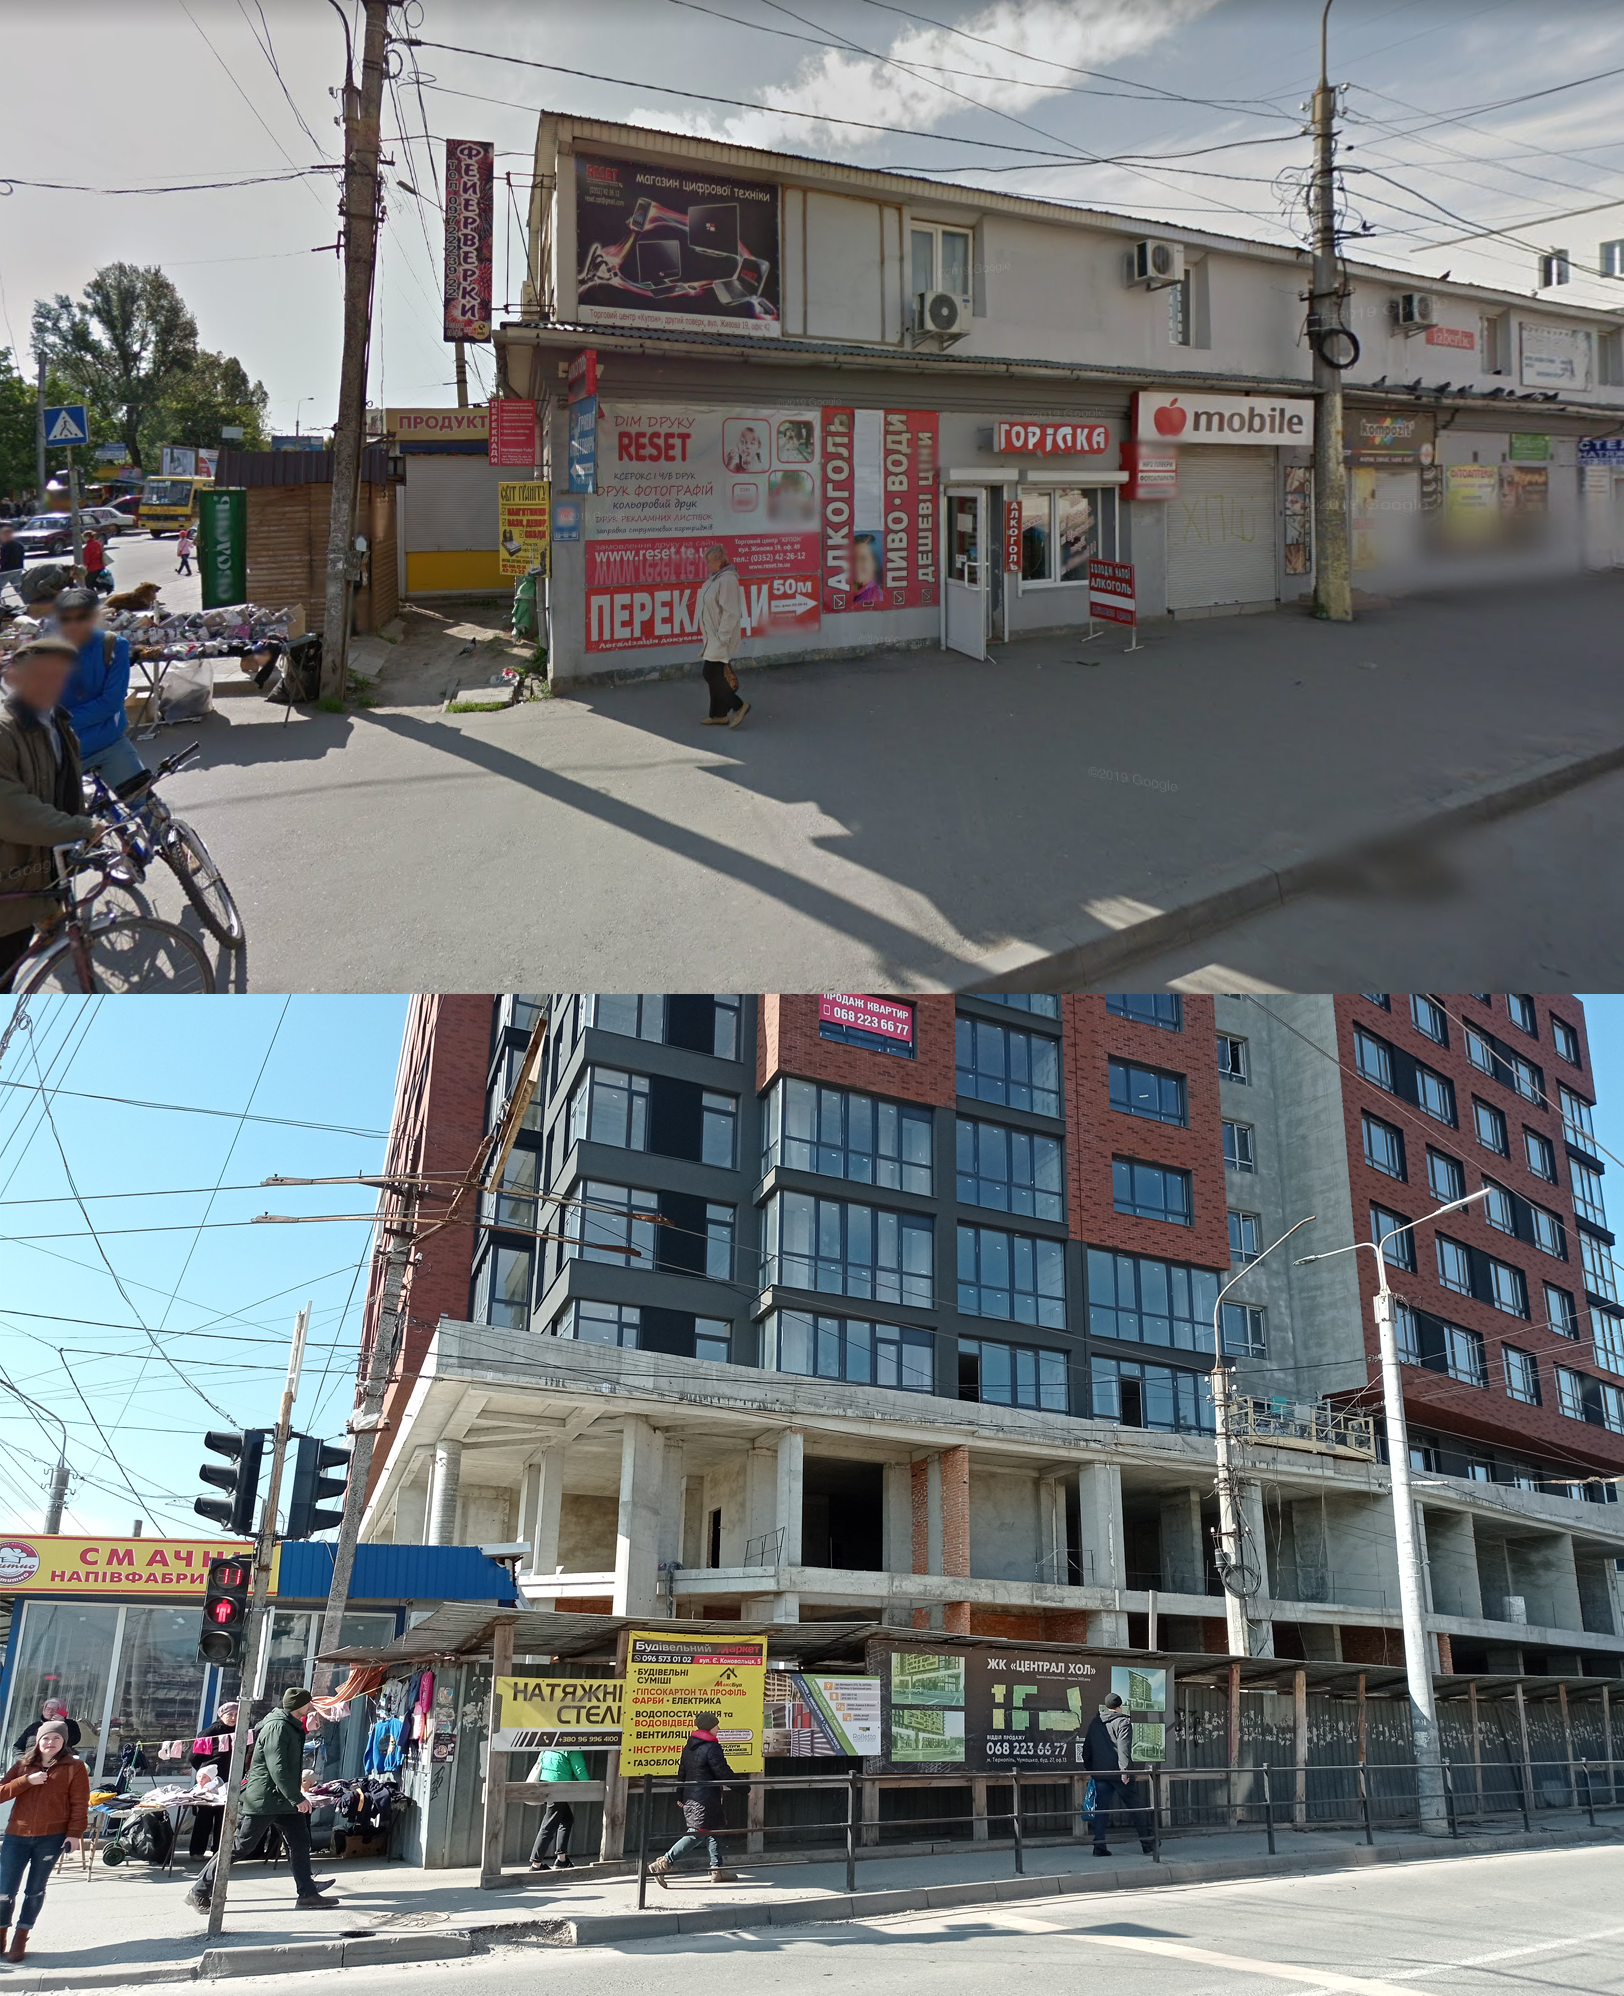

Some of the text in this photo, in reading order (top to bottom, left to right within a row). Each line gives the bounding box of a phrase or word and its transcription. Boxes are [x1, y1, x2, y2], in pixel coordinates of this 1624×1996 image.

[586, 164, 618, 182] RESET
[636, 173, 770, 202] магазин цифрової техніки
[457, 144, 484, 319] ФЕЙЕРВЕРКИ
[590, 308, 617, 320] Торговий
[619, 312, 636, 322] центр
[664, 316, 684, 326] другий
[720, 320, 741, 329] Живова
[399, 415, 488, 432] ПРОДУКТ
[1193, 406, 1304, 435] mobile
[618, 431, 691, 462] RESET
[614, 472, 652, 481] КСЕРОКС
[658, 472, 674, 480] Ч/Б
[596, 482, 713, 498] ДРУК ФОТОГРАФІЙ
[613, 499, 697, 512] кольоровий друк
[825, 413, 851, 592] АЛКОГОЛЬ
[886, 414, 913, 588] ПИВО ВОДИ
[621, 515, 672, 523] РЕКЛАМНИХ
[596, 527, 627, 535] заправка
[917, 494, 936, 583] ДЕШЕВІ
[1009, 502, 1019, 571] АЛКОГОЛЬ
[748, 562, 791, 570] www.reset.te.ua
[750, 554, 773, 564] (0352)
[774, 552, 806, 561] 42-26-12
[1090, 579, 1132, 594] АЛКОГОЛЬ
[591, 584, 768, 641] ПЕРЕКДИ
[823, 994, 909, 1020] ПРОДАЖ КВАРТИР
[833, 1006, 909, 1036] 068 223 66 77
[635, 1641, 712, 1654] Будівельний
[642, 1655, 658, 1663] 096
[720, 1658, 757, 1666] Коновальця,
[987, 1658, 1096, 1675] ЖК «ЦЕНТРАЛ ХОЛ»
[637, 1668, 689, 1677] БУДІВЕЛЬНІ
[637, 1676, 672, 1684] СУМІШІ
[512, 1682, 624, 1702] НАТЯЖНІ
[636, 1688, 747, 1696] ГІПСОКАРТОН ТА ПРОФІЛЬ
[632, 1697, 722, 1705] ФАРБИ ЕЛЕКТРИКА
[635, 1710, 722, 1719] ВОДОПОСТАЧНЯ
[986, 1742, 1067, 1755] 068 223 66 77
